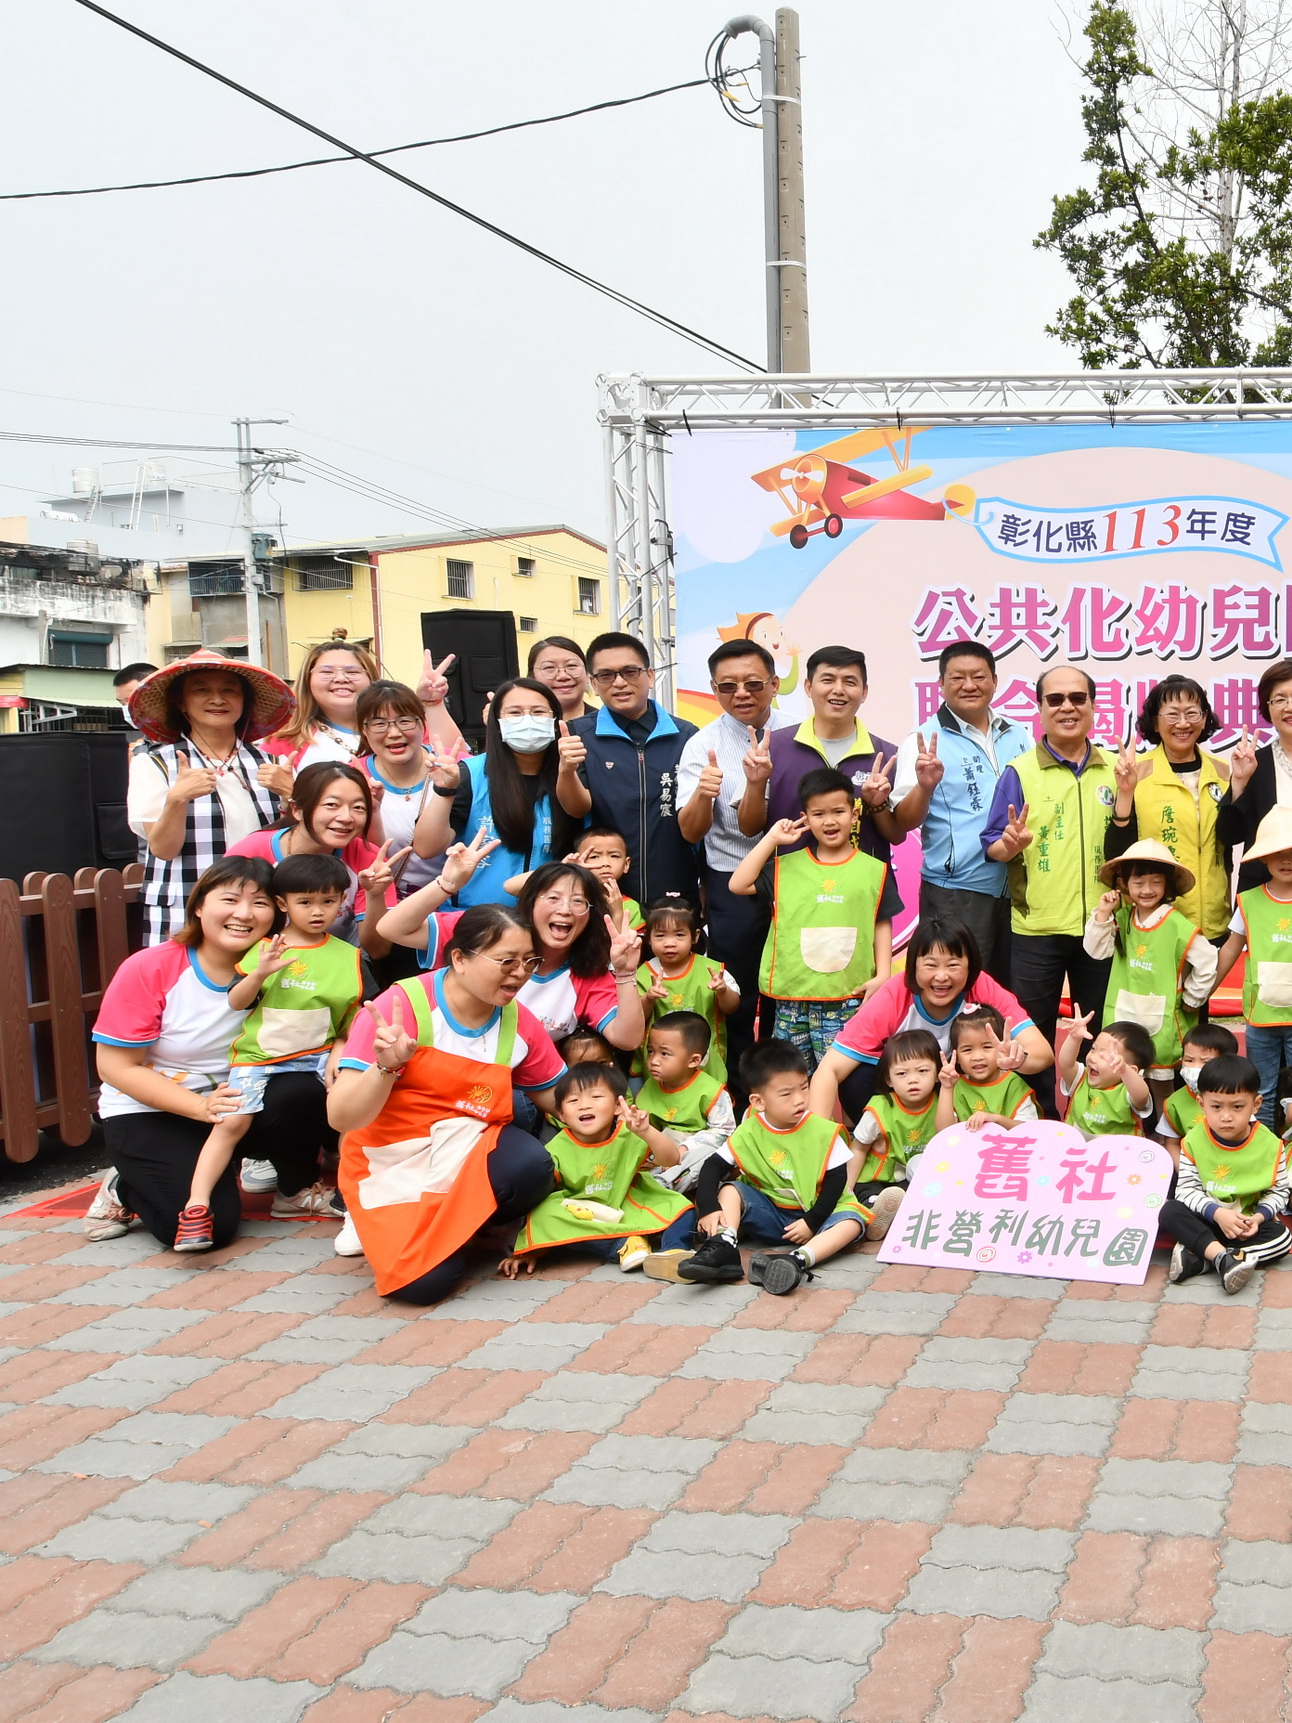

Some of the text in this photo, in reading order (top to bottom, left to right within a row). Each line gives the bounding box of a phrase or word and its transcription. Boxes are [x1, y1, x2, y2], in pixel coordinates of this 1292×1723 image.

[998, 504, 1256, 553] 彰化縣113年度
[1055, 802, 1064, 840] 副主任
[974, 1133, 1118, 1204] 舊社
[901, 1207, 1149, 1268] 非營利幼兒園
